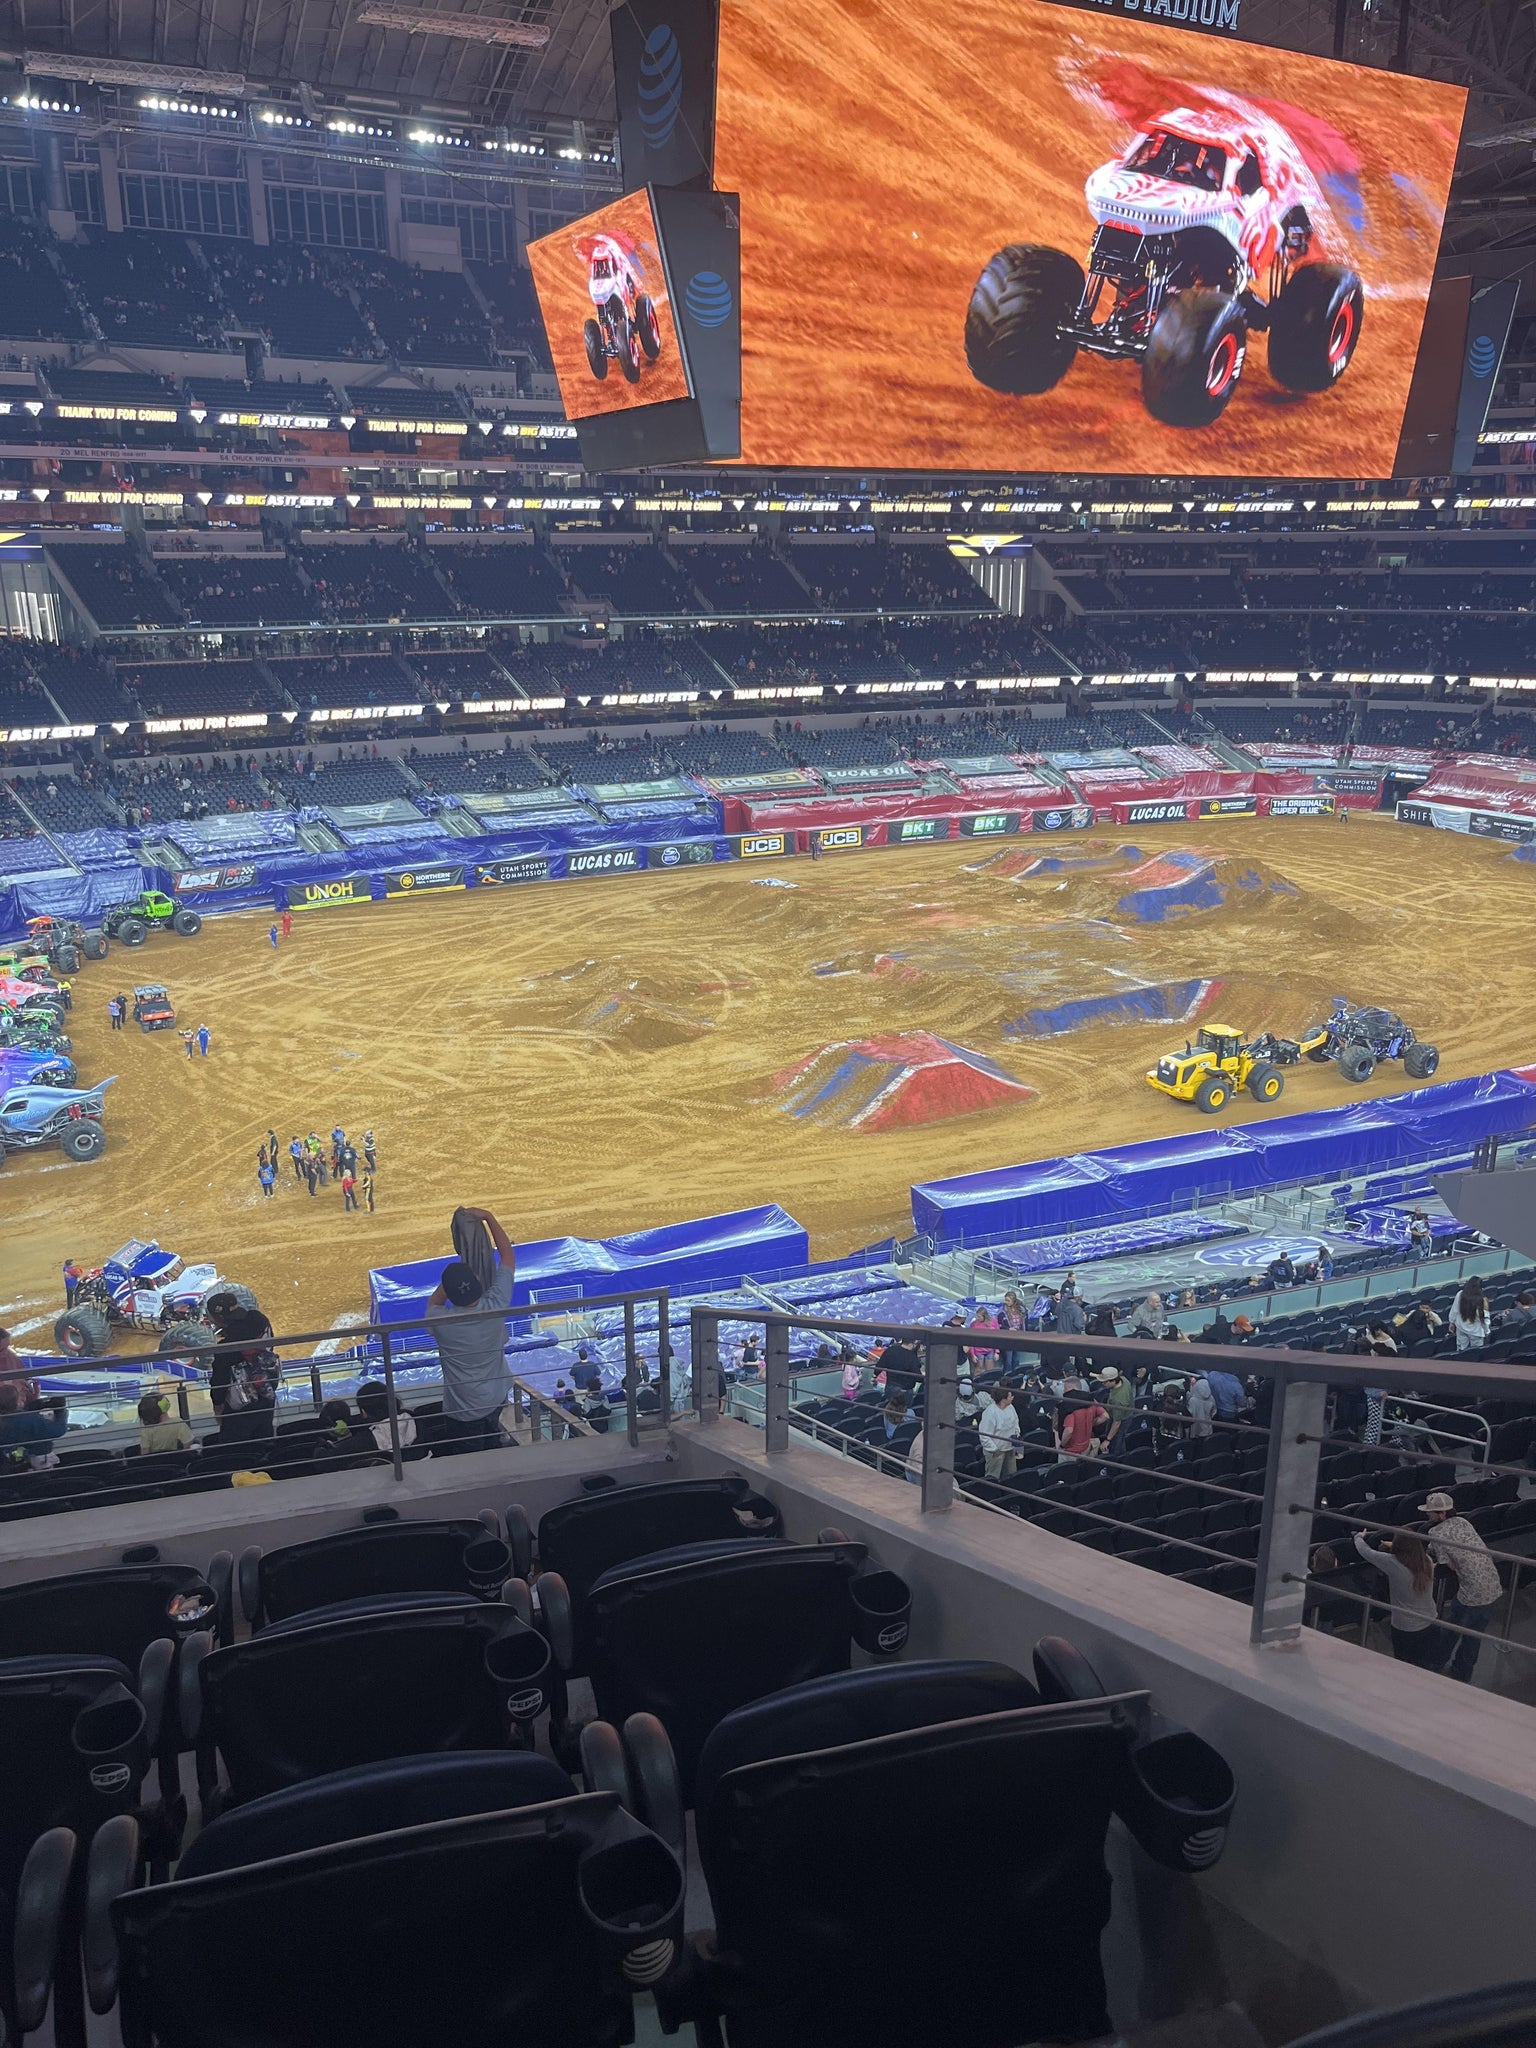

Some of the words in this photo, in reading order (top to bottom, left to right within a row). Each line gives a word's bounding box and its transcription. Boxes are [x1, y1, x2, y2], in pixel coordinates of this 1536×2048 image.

[58, 406, 93, 419] THANK
[95, 408, 114, 420] YOU
[116, 408, 136, 421] FOR
[138, 409, 177, 422] COMING
[219, 413, 238, 424] AS
[239, 414, 261, 426] BIG
[261, 415, 280, 427] AS
[280, 416, 293, 427] IT
[368, 420, 397, 432] THANK
[398, 422, 415, 432] YOU
[416, 422, 434, 433] FOR
[434, 423, 468, 434] COMING
[503, 426, 519, 436] AS
[520, 427, 539, 437] BIG
[539, 427, 556, 437] AS
[556, 428, 569, 438] IT
[91, 450, 120, 458] RENFRO
[65, 492, 100, 503] THANK
[101, 492, 121, 503] YOU
[123, 493, 143, 504] FOR
[144, 493, 184, 505] COMING
[225, 494, 244, 504] AS
[244, 494, 267, 505] BIG
[267, 495, 286, 505] AS
[286, 495, 300, 506] IT
[373, 497, 402, 508] THANK
[403, 498, 420, 508] YOU
[421, 498, 438, 508] FOR
[439, 498, 472, 509] COMING
[507, 498, 523, 509] AS
[523, 499, 542, 509] BIG
[542, 499, 558, 509] AS
[558, 499, 571, 509] IT
[635, 500, 661, 510] THANK
[661, 501, 677, 510] YOU
[677, 501, 693, 511] FOR
[693, 501, 723, 511] COMING
[754, 502, 769, 511] AS
[769, 502, 786, 511] BIG
[786, 502, 801, 511] AS
[801, 502, 811, 511] IT
[870, 502, 894, 512] THANK
[894, 503, 909, 512] YOU
[909, 503, 923, 512] FOR
[924, 503, 952, 512] COMING
[981, 502, 995, 512] AS
[995, 503, 1010, 512] BIG
[1011, 503, 1025, 512] AS
[1025, 503, 1035, 512] IT
[1091, 503, 1114, 512] THANK
[1114, 503, 1128, 512] YOU
[1128, 503, 1144, 512] FOR
[1144, 503, 1173, 512] COMING
[1203, 503, 1217, 512] AS
[1218, 503, 1235, 512] BIG
[1235, 503, 1251, 512] AS
[1251, 503, 1263, 512] IT
[1326, 502, 1352, 511] THANK
[1352, 501, 1368, 511] YOU
[1369, 501, 1386, 510] FOR
[1387, 500, 1419, 510] COMING
[463, 701, 494, 713] THANK
[494, 700, 513, 711] YOU
[513, 699, 531, 711] FOR
[532, 698, 566, 710] COMING
[146, 718, 181, 733] THANK
[182, 717, 204, 731] YOU
[204, 716, 226, 730] FOR
[227, 714, 267, 729] COMING
[827, 769, 879, 777] LUCAS
[882, 766, 909, 776] OIL
[1130, 807, 1166, 820] LUCAS
[902, 822, 935, 834] BKT
[974, 817, 1006, 830] BKT
[823, 831, 858, 846] JCB
[744, 838, 781, 853] JCB
[500, 865, 519, 873] UTAH
[521, 862, 547, 870] SPORTS
[569, 853, 612, 871] LUCAS
[226, 868, 240, 877] RC
[415, 872, 451, 881] NORTHERN
[500, 869, 547, 880] COMMISSION
[224, 875, 253, 886] CARS
[305, 881, 354, 900] UNOH
[510, 1694, 541, 1708] PEPSI
[93, 1769, 128, 1783] PEPSI
